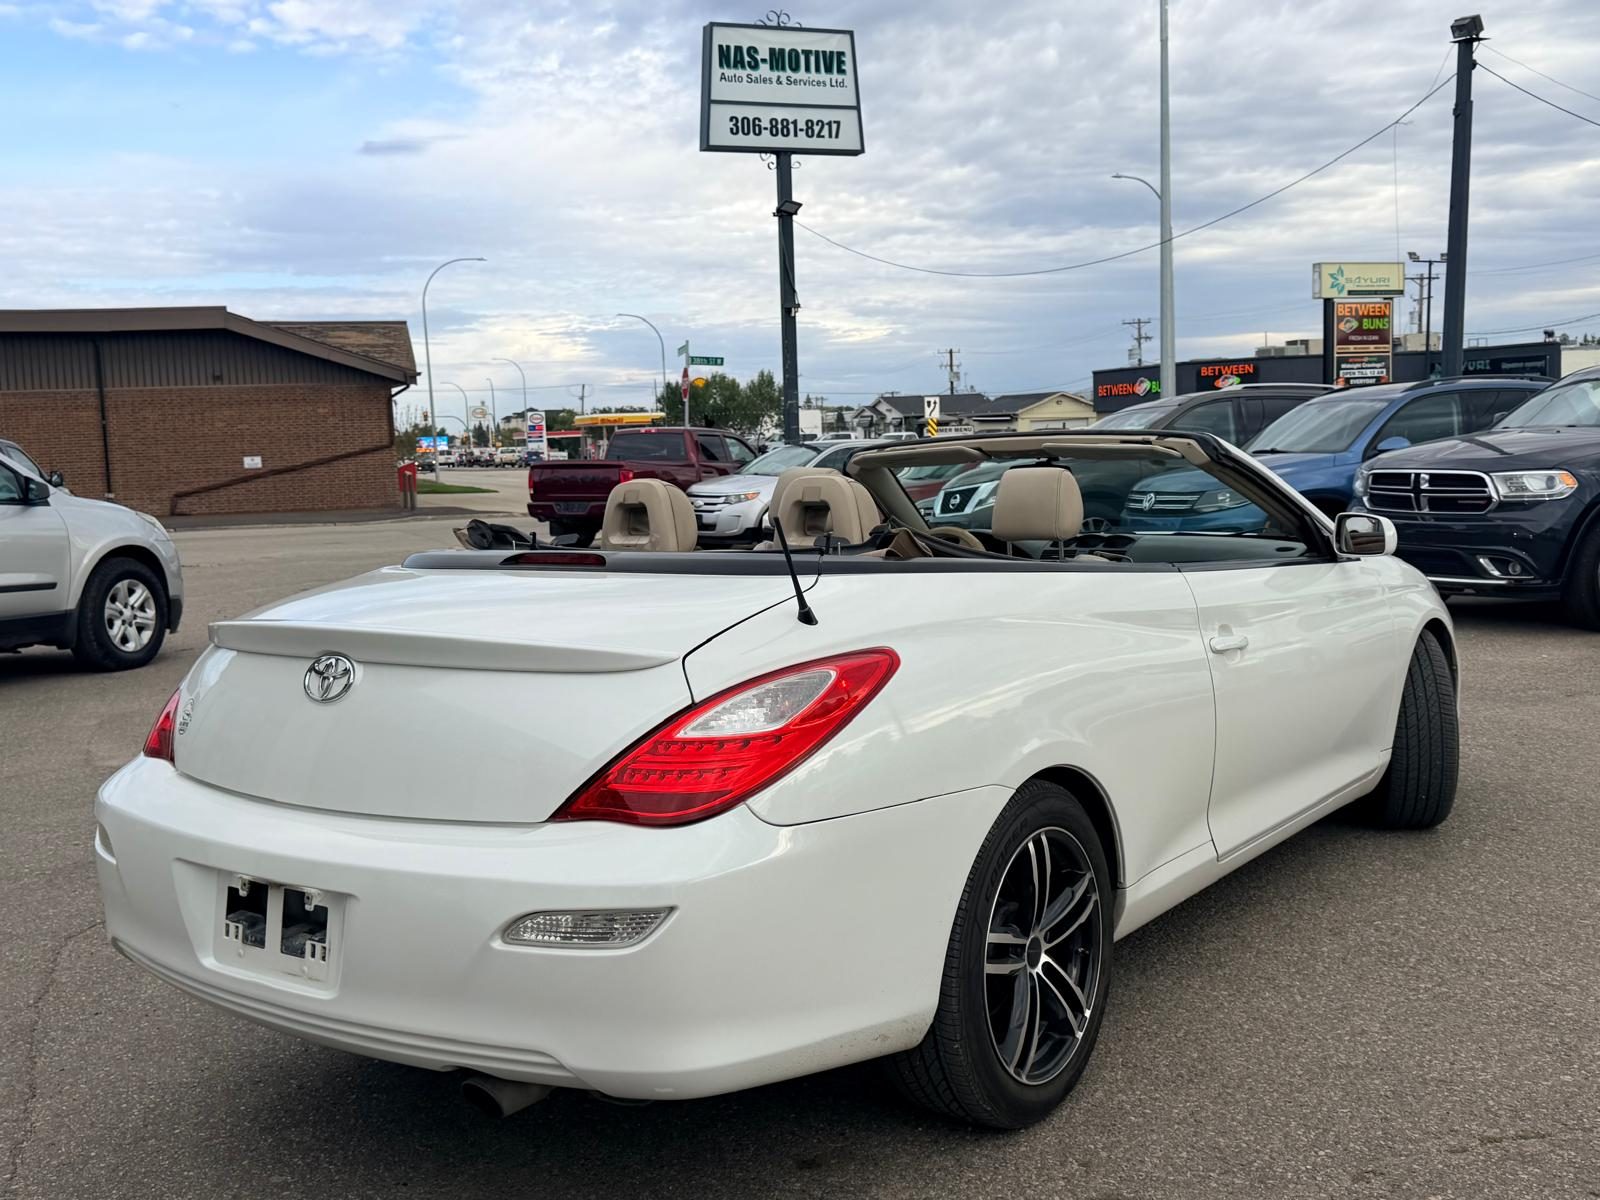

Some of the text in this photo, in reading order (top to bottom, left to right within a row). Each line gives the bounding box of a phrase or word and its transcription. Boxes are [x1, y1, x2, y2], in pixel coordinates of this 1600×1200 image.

[717, 44, 847, 76] NAS-MOTIVE
[719, 72, 848, 89] Auto Sales & Services Ltd.
[728, 115, 841, 139] 306-881-8217
[1337, 304, 1389, 316] BETWEEN
[1362, 318, 1389, 330] BUNS
[1201, 363, 1254, 377] BETWEEN
[1098, 383, 1134, 397] BETWEEN
